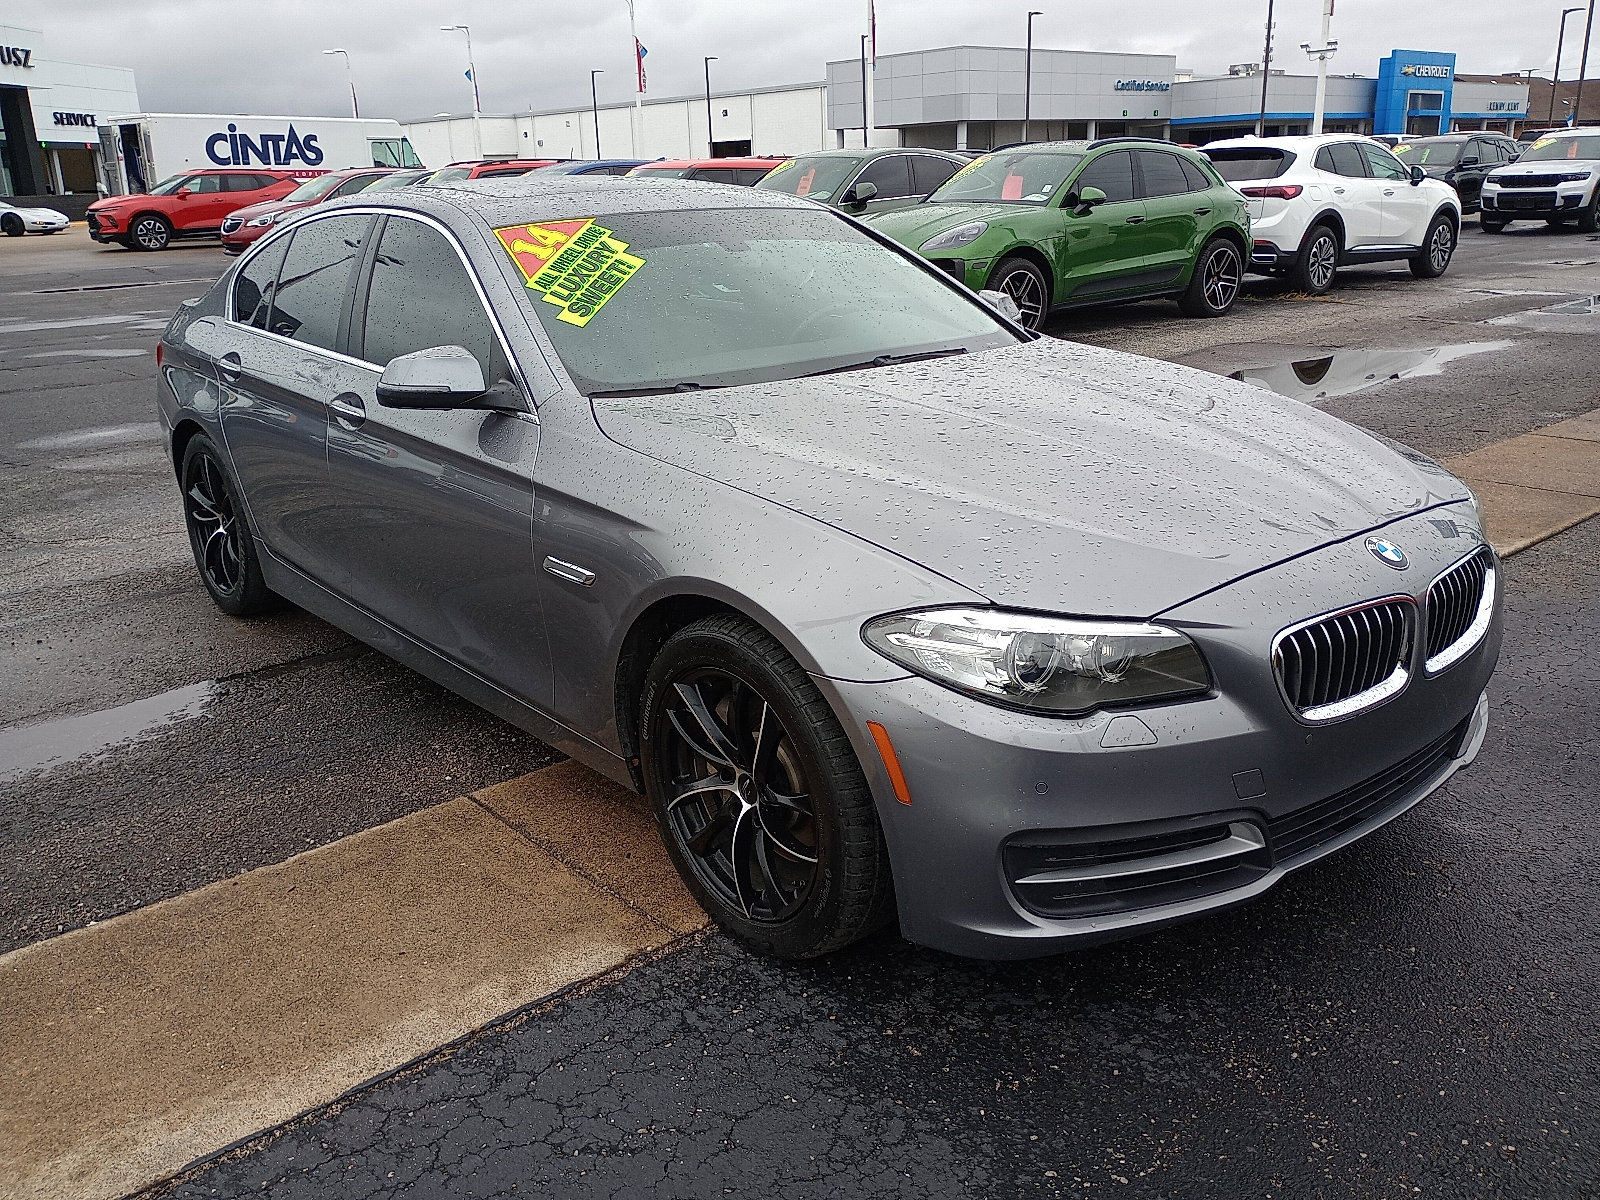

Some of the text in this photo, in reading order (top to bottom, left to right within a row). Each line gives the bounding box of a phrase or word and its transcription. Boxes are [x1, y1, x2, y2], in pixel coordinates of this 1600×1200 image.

[1115, 79, 1170, 91] Certified Service
[1415, 66, 1450, 78] CHEVROLET
[53, 112, 97, 127] SERVICE
[534, 226, 606, 290] ALL WHEEL DRIVE
[549, 240, 619, 302] LUXURY
[567, 258, 637, 318] SWEET!
